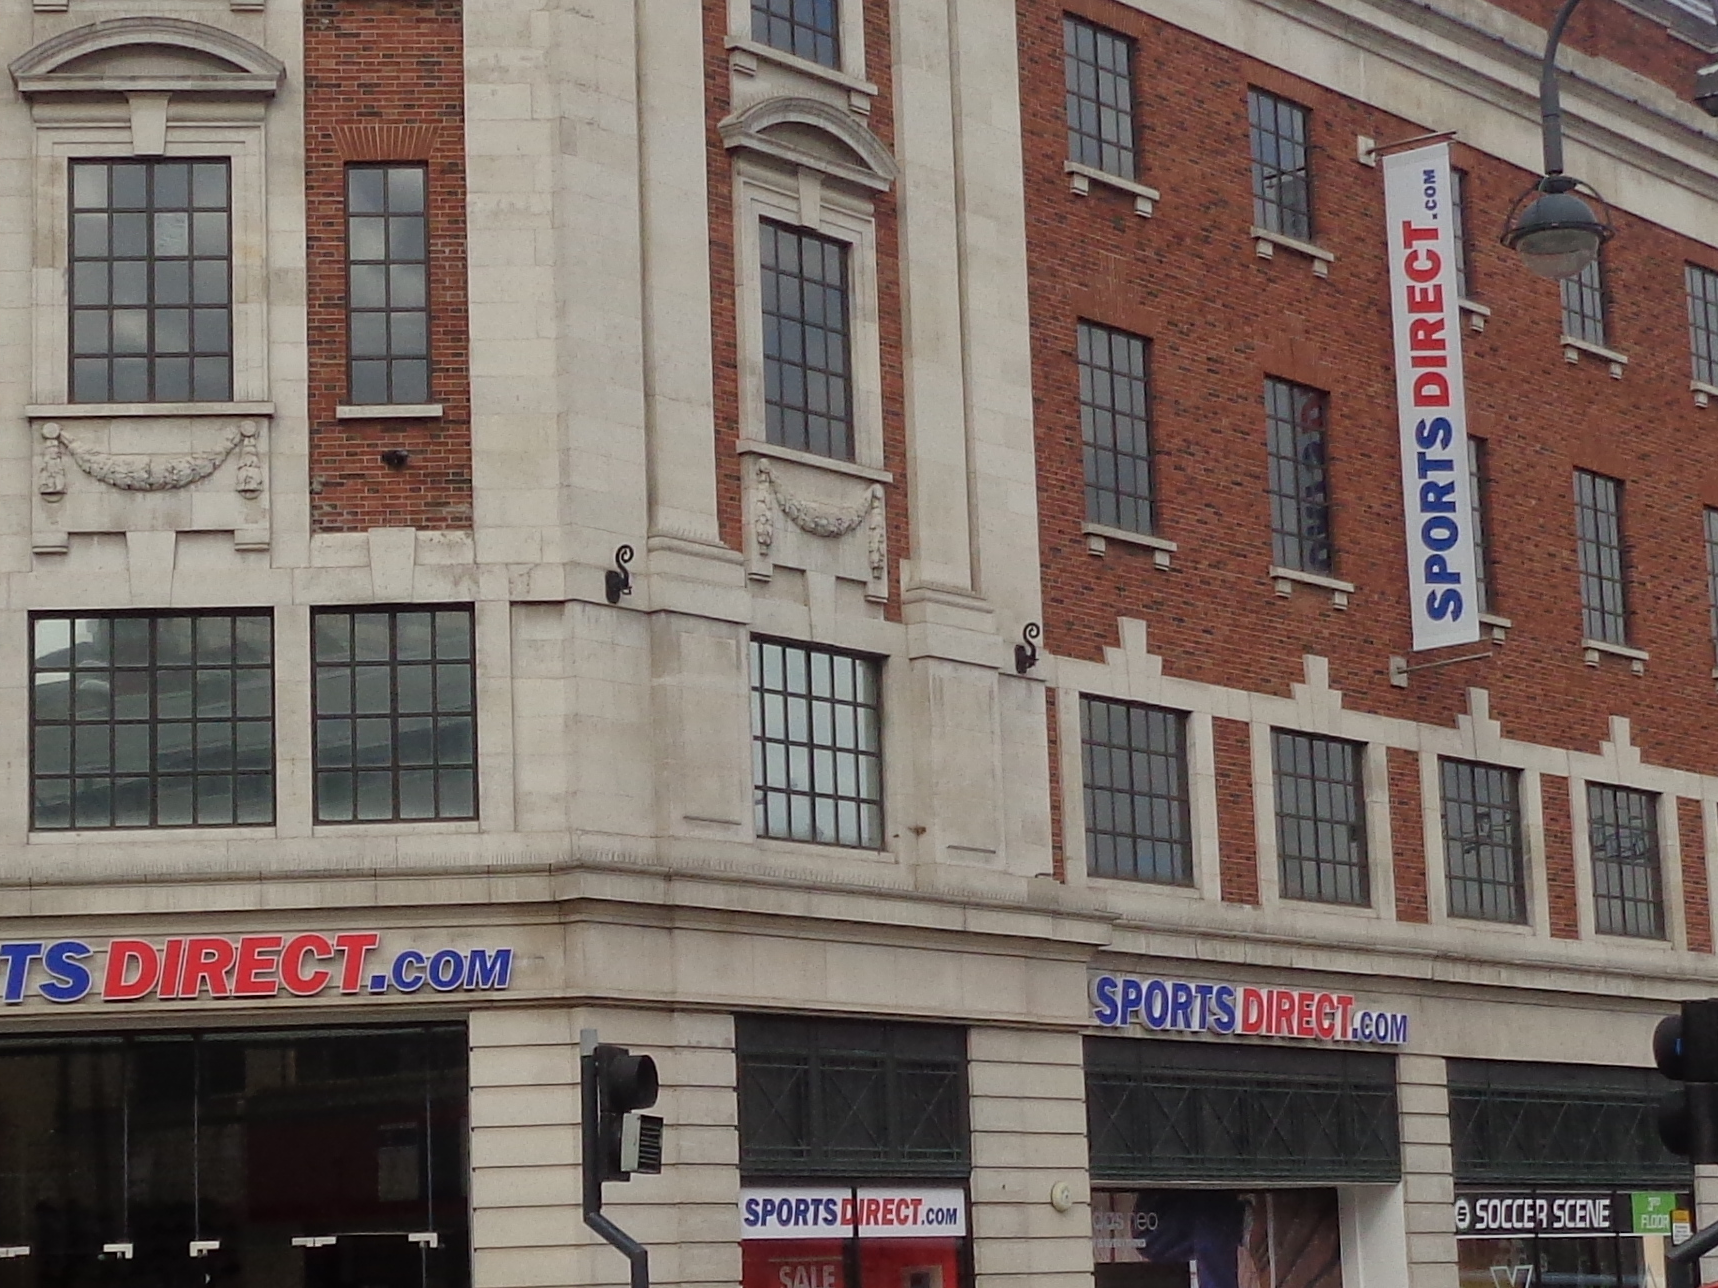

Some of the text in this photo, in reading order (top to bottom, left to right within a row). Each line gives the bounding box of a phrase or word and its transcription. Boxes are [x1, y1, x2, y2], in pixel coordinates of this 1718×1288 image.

[1131, 1213, 1158, 1231] neo
[1474, 1198, 1611, 1230] SOCCER SCENE
[1641, 1214, 1670, 1230] FLOOR
